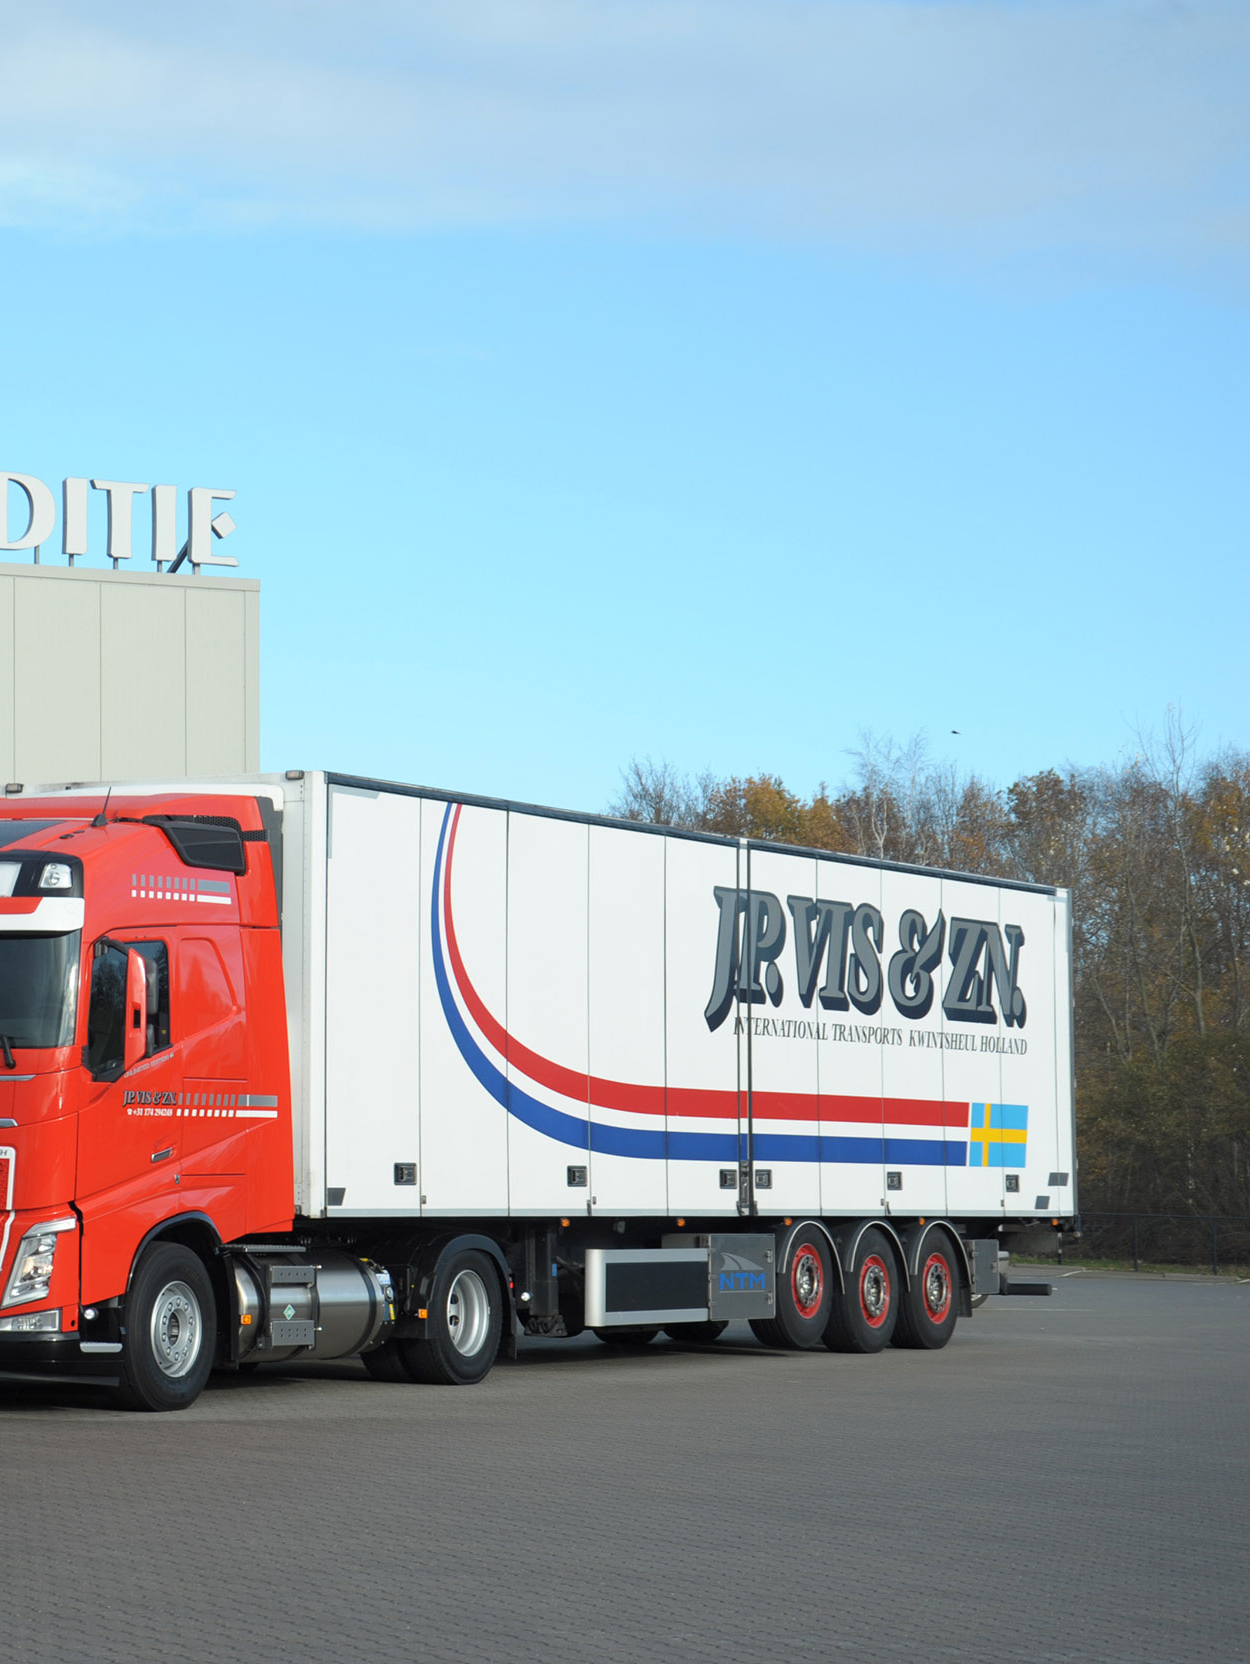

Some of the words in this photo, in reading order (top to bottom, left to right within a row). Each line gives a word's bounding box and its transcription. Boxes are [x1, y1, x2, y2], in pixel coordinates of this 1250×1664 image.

[704, 885, 786, 1033] JP.
[787, 894, 884, 1016] VIS
[888, 908, 946, 1020] &
[942, 916, 1027, 1029] ZN.
[733, 1015, 828, 1041] INTERNATIONAL
[831, 1022, 902, 1047] TRANSPORTS
[909, 1029, 977, 1052] KWINTSHEUL
[980, 1035, 1027, 1056] HOLLAND
[136, 1091, 151, 1104] VIS
[152, 1091, 163, 1105] &
[719, 1272, 766, 1290] NTM
